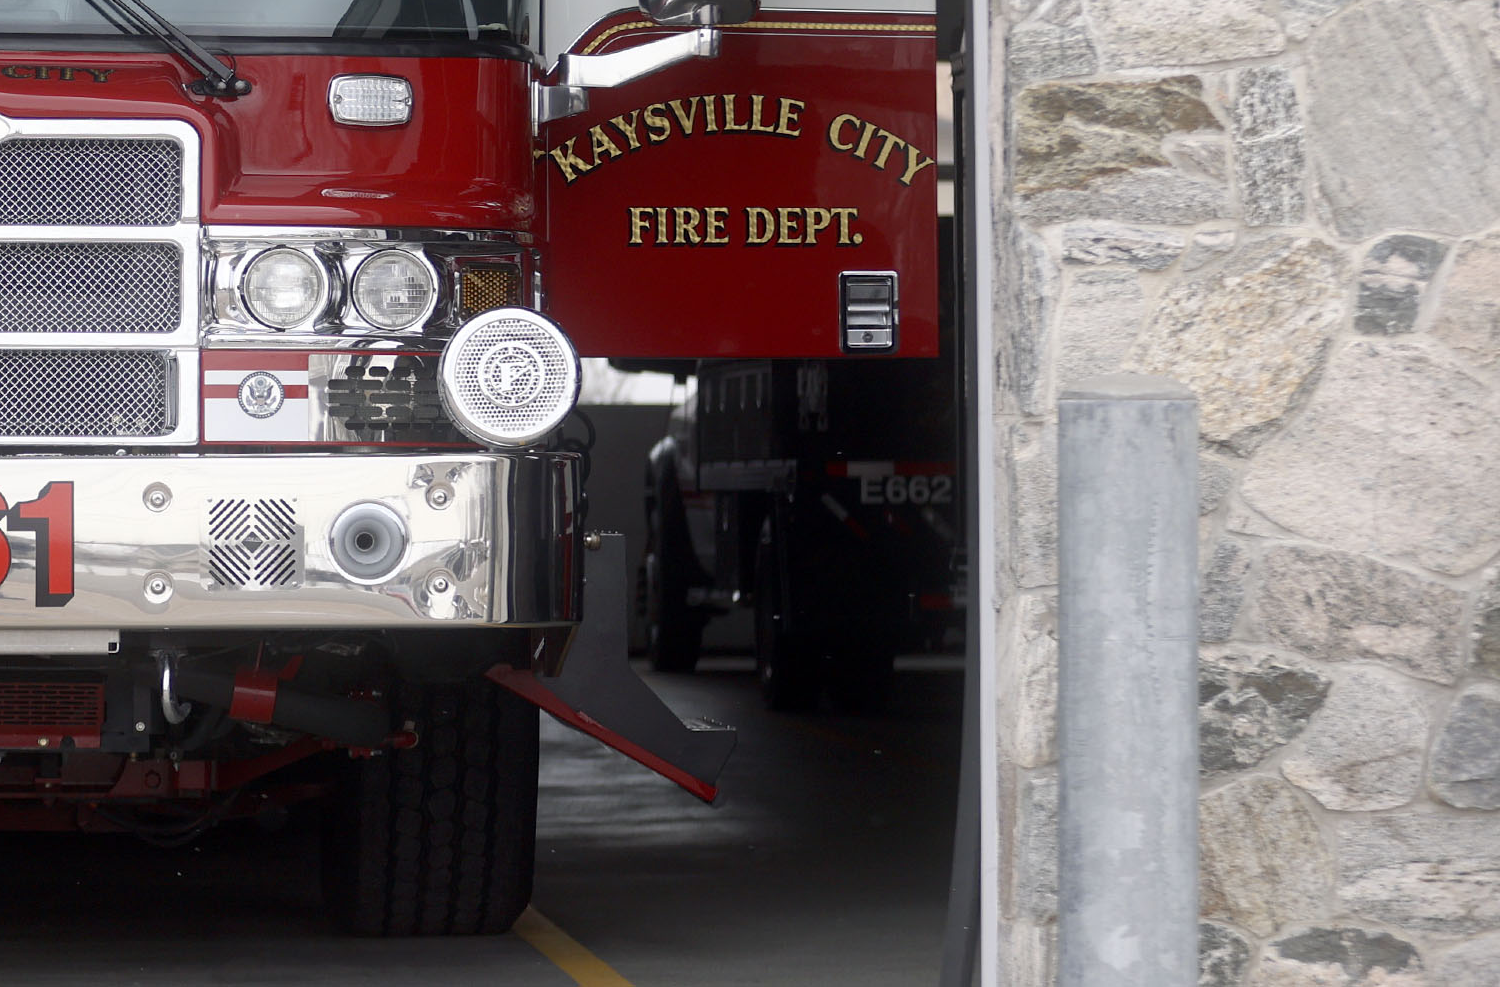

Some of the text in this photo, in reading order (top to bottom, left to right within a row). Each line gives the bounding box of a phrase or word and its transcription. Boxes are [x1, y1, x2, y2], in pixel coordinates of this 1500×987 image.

[1, 65, 116, 83] CITY
[548, 93, 936, 187] KAYSVILLE CITY
[627, 206, 864, 246] FIRE DEPT.
[860, 475, 952, 505] E662
